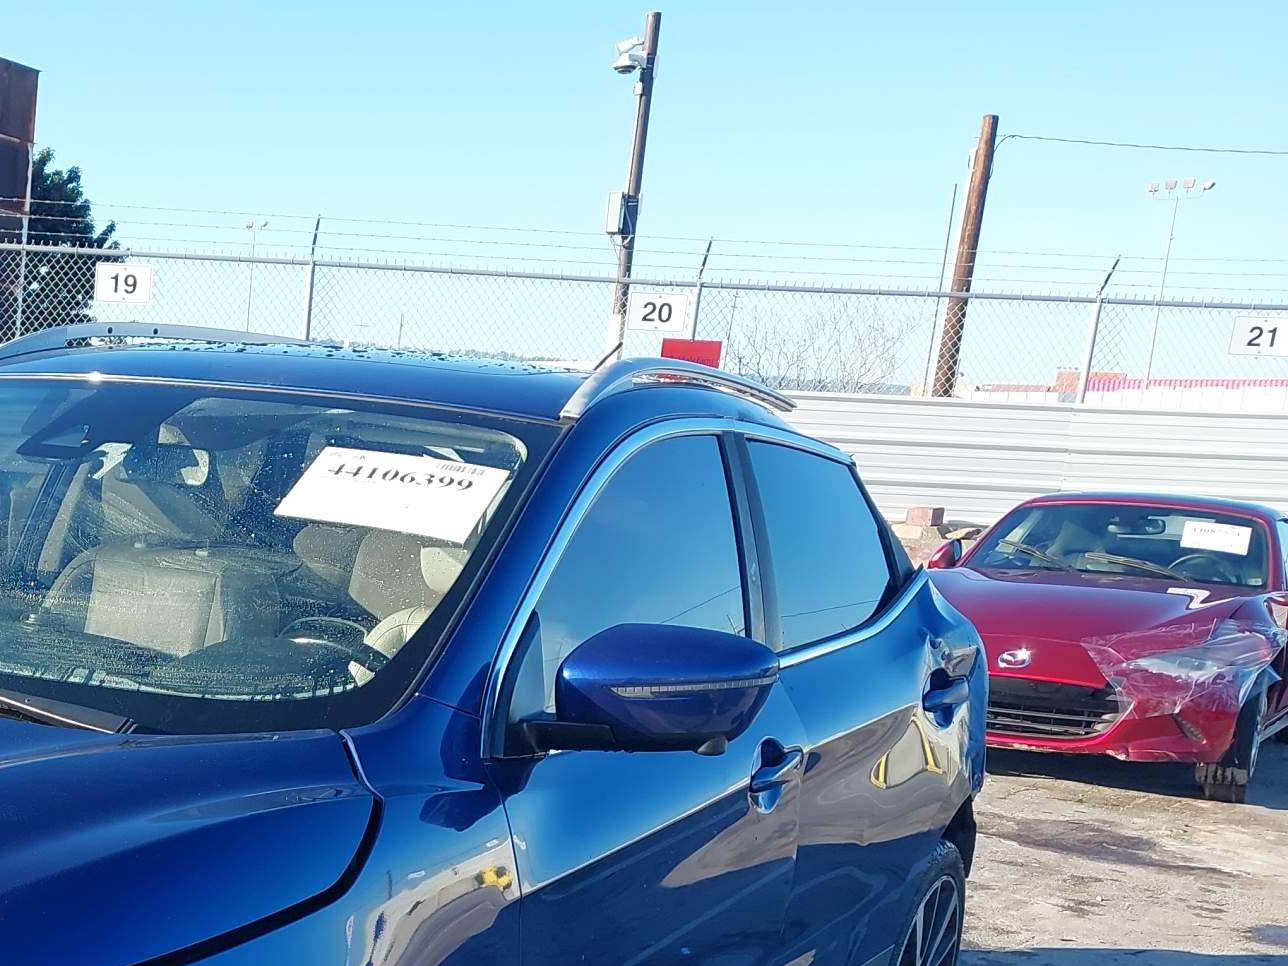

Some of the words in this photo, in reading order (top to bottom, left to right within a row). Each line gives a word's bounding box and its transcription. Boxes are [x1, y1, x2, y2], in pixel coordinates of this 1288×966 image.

[110, 273, 138, 295] 19
[641, 302, 673, 323] 20
[1246, 326, 1278, 347] 21
[328, 463, 473, 491] 44106399
